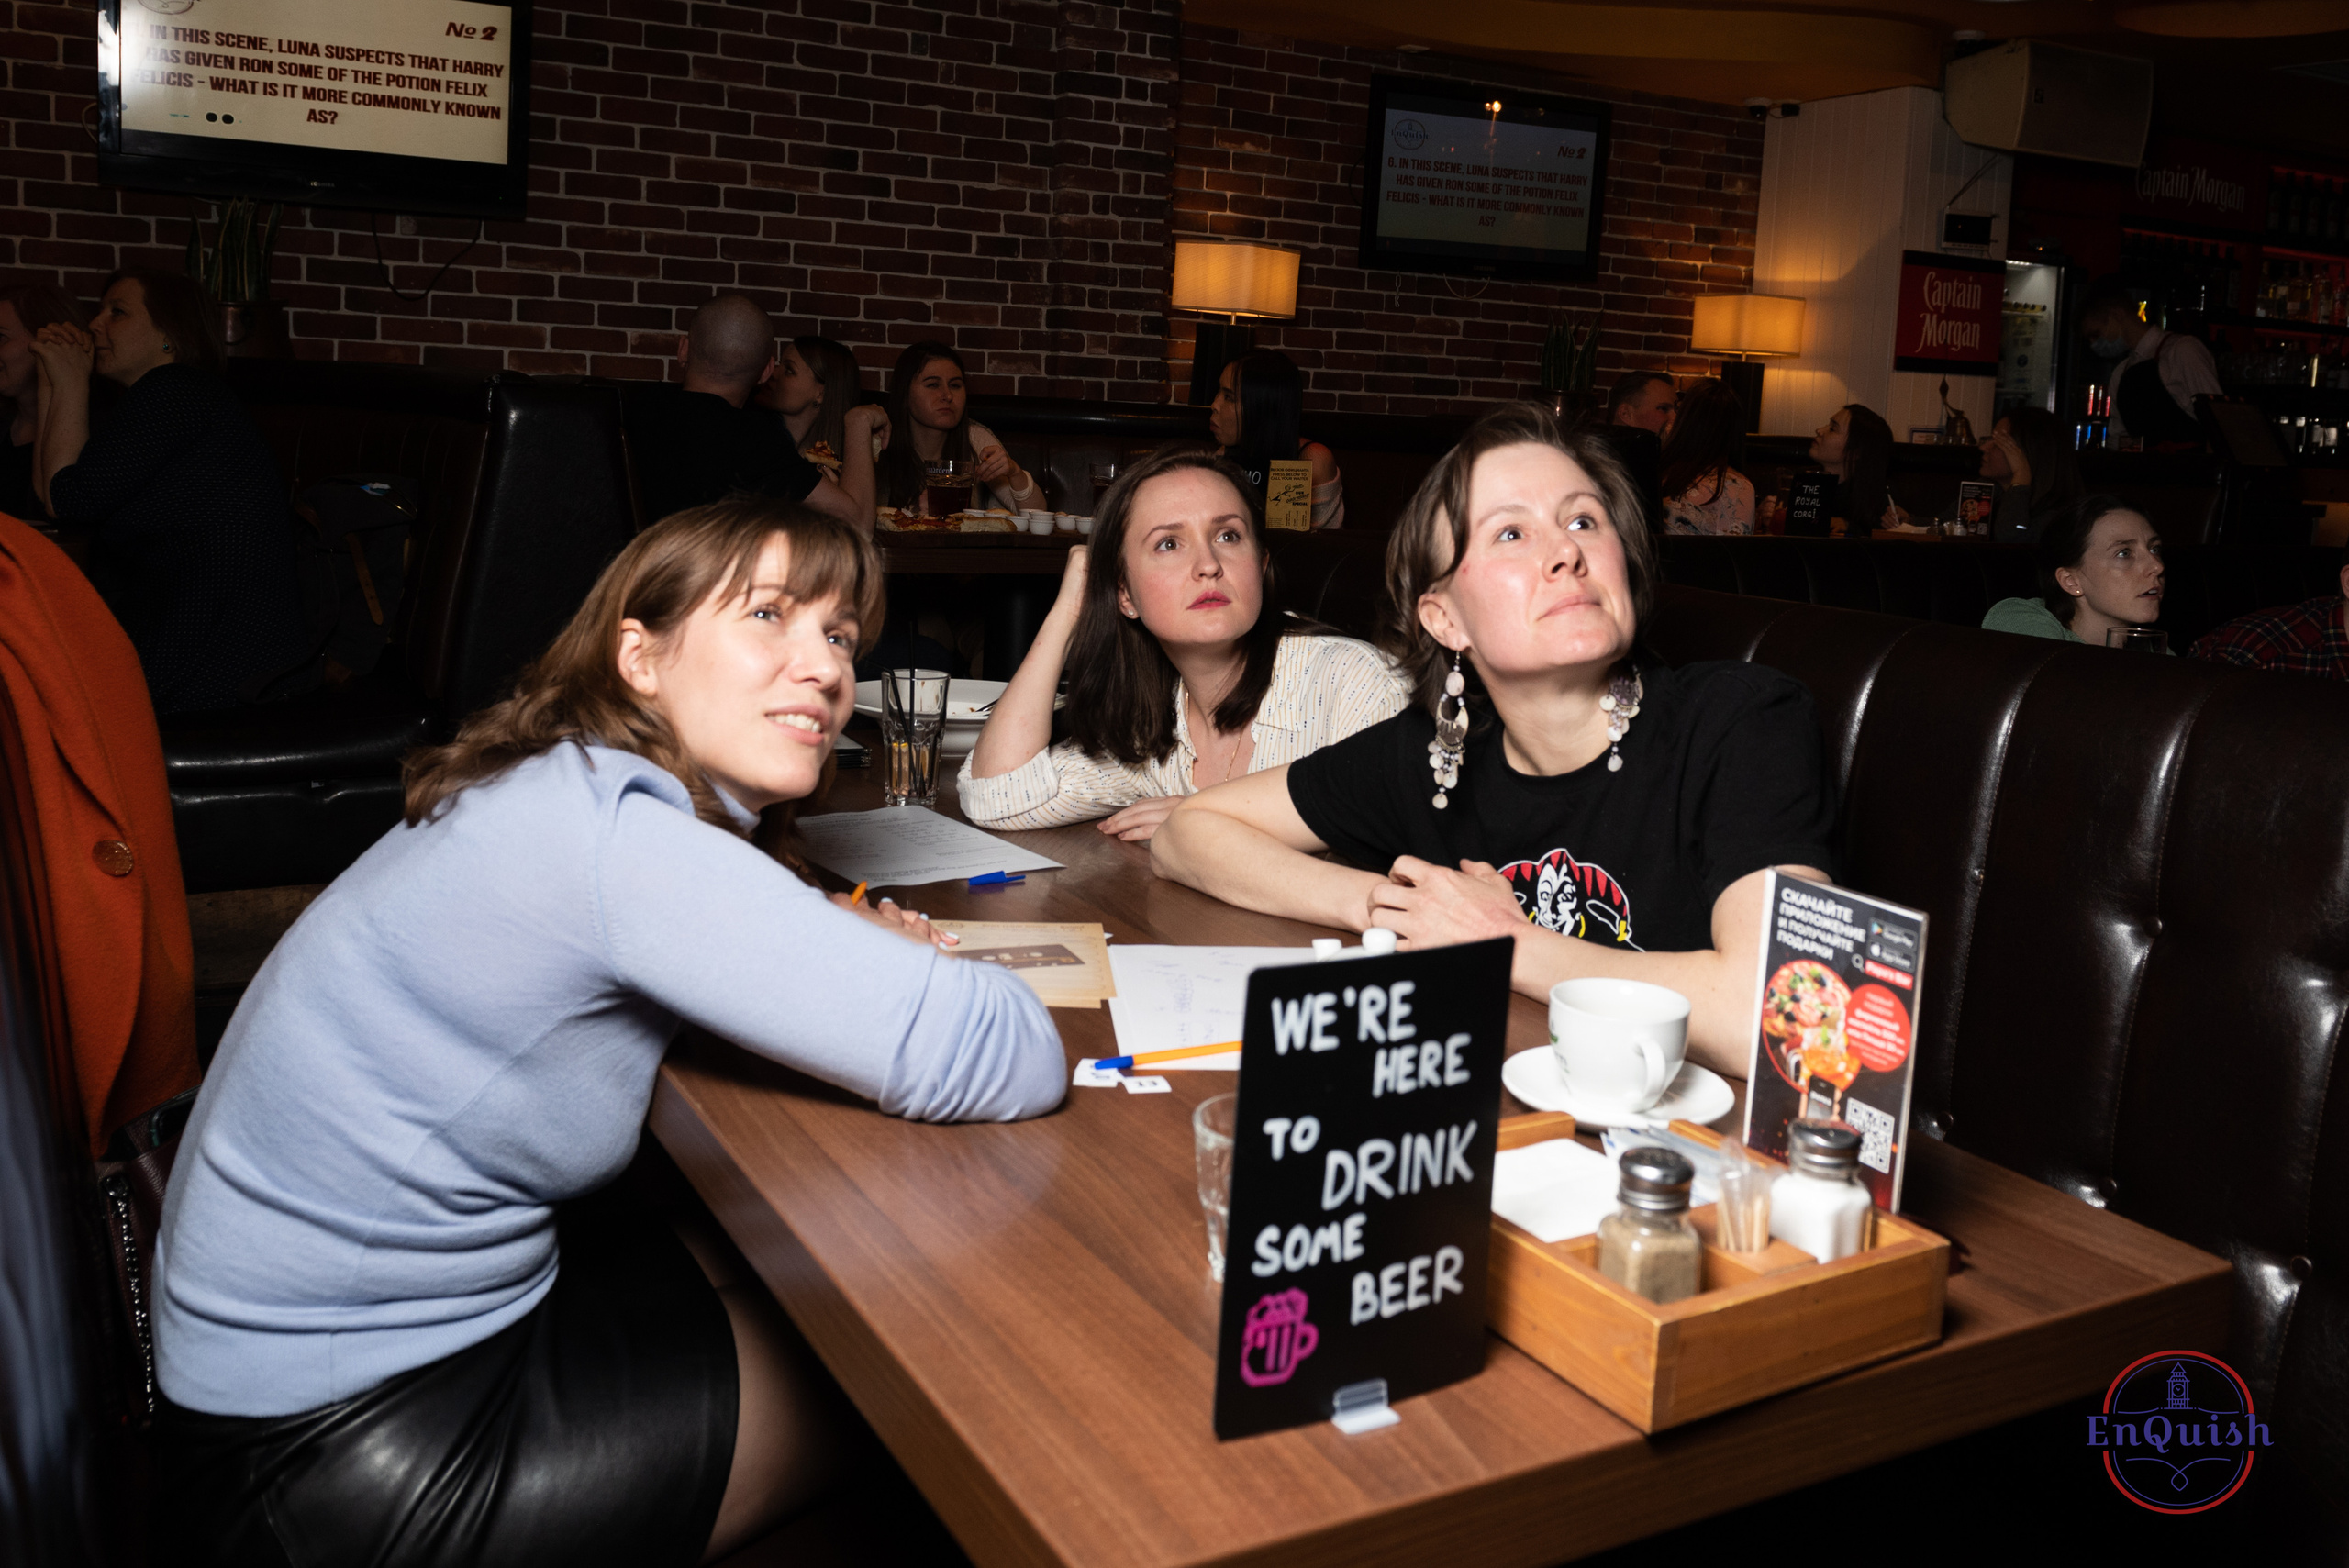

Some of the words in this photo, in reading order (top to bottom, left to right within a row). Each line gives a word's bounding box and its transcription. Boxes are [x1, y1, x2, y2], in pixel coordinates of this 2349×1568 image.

[150, 24, 167, 39] IN
[171, 26, 210, 44] THIS
[215, 31, 273, 53] SCENE,
[278, 39, 320, 57] LUNA
[325, 44, 405, 66] SUSPECTS
[408, 54, 449, 72] THAT
[452, 60, 504, 78] HARRY
[479, 26, 497, 41] 2
[185, 50, 235, 70] GIVEN
[239, 57, 273, 74] RON
[277, 61, 323, 80] SOME
[328, 67, 348, 82] OF
[351, 69, 382, 86] THE
[386, 73, 441, 93] POTION
[446, 80, 488, 97] FELIX
[209, 76, 259, 95] WHAT
[263, 82, 278, 96] IS
[283, 84, 297, 99] IT
[302, 86, 348, 104] MORE
[352, 92, 441, 114] COMMONLY
[445, 102, 501, 120] KNOWN
[306, 108, 338, 124] AS?
[1397, 174, 1415, 186] HAS
[1417, 177, 1443, 189] GIVEN
[1445, 179, 1464, 191] RON
[1465, 182, 1490, 194] SOME
[1492, 183, 1503, 195] OF
[1505, 184, 1521, 196] THE
[1523, 186, 1553, 199] POTION
[1554, 190, 1578, 201] FELIX
[1399, 158, 1408, 169] IN
[1411, 159, 1431, 172] THIS
[1433, 161, 1464, 175] SCENE,
[1467, 164, 1489, 177] LUNA
[1492, 167, 1534, 182] SUSPECTS
[1536, 172, 1559, 183] THAT
[1561, 174, 1588, 186] HARRY
[2134, 161, 2189, 204] Captain
[2185, 165, 2245, 213] Morgan
[1386, 190, 1419, 204] FELICIS
[1429, 194, 1454, 206] WHAT
[1456, 197, 1464, 208] IS
[1467, 198, 1475, 209] IT
[1477, 199, 1502, 211] MORE
[1504, 201, 1552, 216] COMMONLY
[1553, 206, 1585, 218] KNOWN
[1478, 215, 1496, 227] AS?
[1923, 271, 1982, 314] Captain
[1914, 312, 1981, 353] Morgan
[1794, 496, 1821, 506] ROYAL
[1802, 484, 1820, 495] THE
[1778, 902, 1866, 943] ПРИЛОЖЕНИЕ
[1781, 887, 1854, 924] СКАЧАЙТЕ
[1776, 929, 1834, 961] ПОДАРКИ
[1777, 916, 1788, 929] И
[1787, 919, 1854, 953] ПОЛУЧАЙТЕ
[1271, 980, 1417, 1055] WE'RE
[1373, 1033, 1471, 1098] HERE
[1263, 1115, 1321, 1161] TO
[1321, 1120, 1478, 1210] DRINK
[1251, 1212, 1367, 1277] SOME
[1351, 1246, 1464, 1325] BEER
